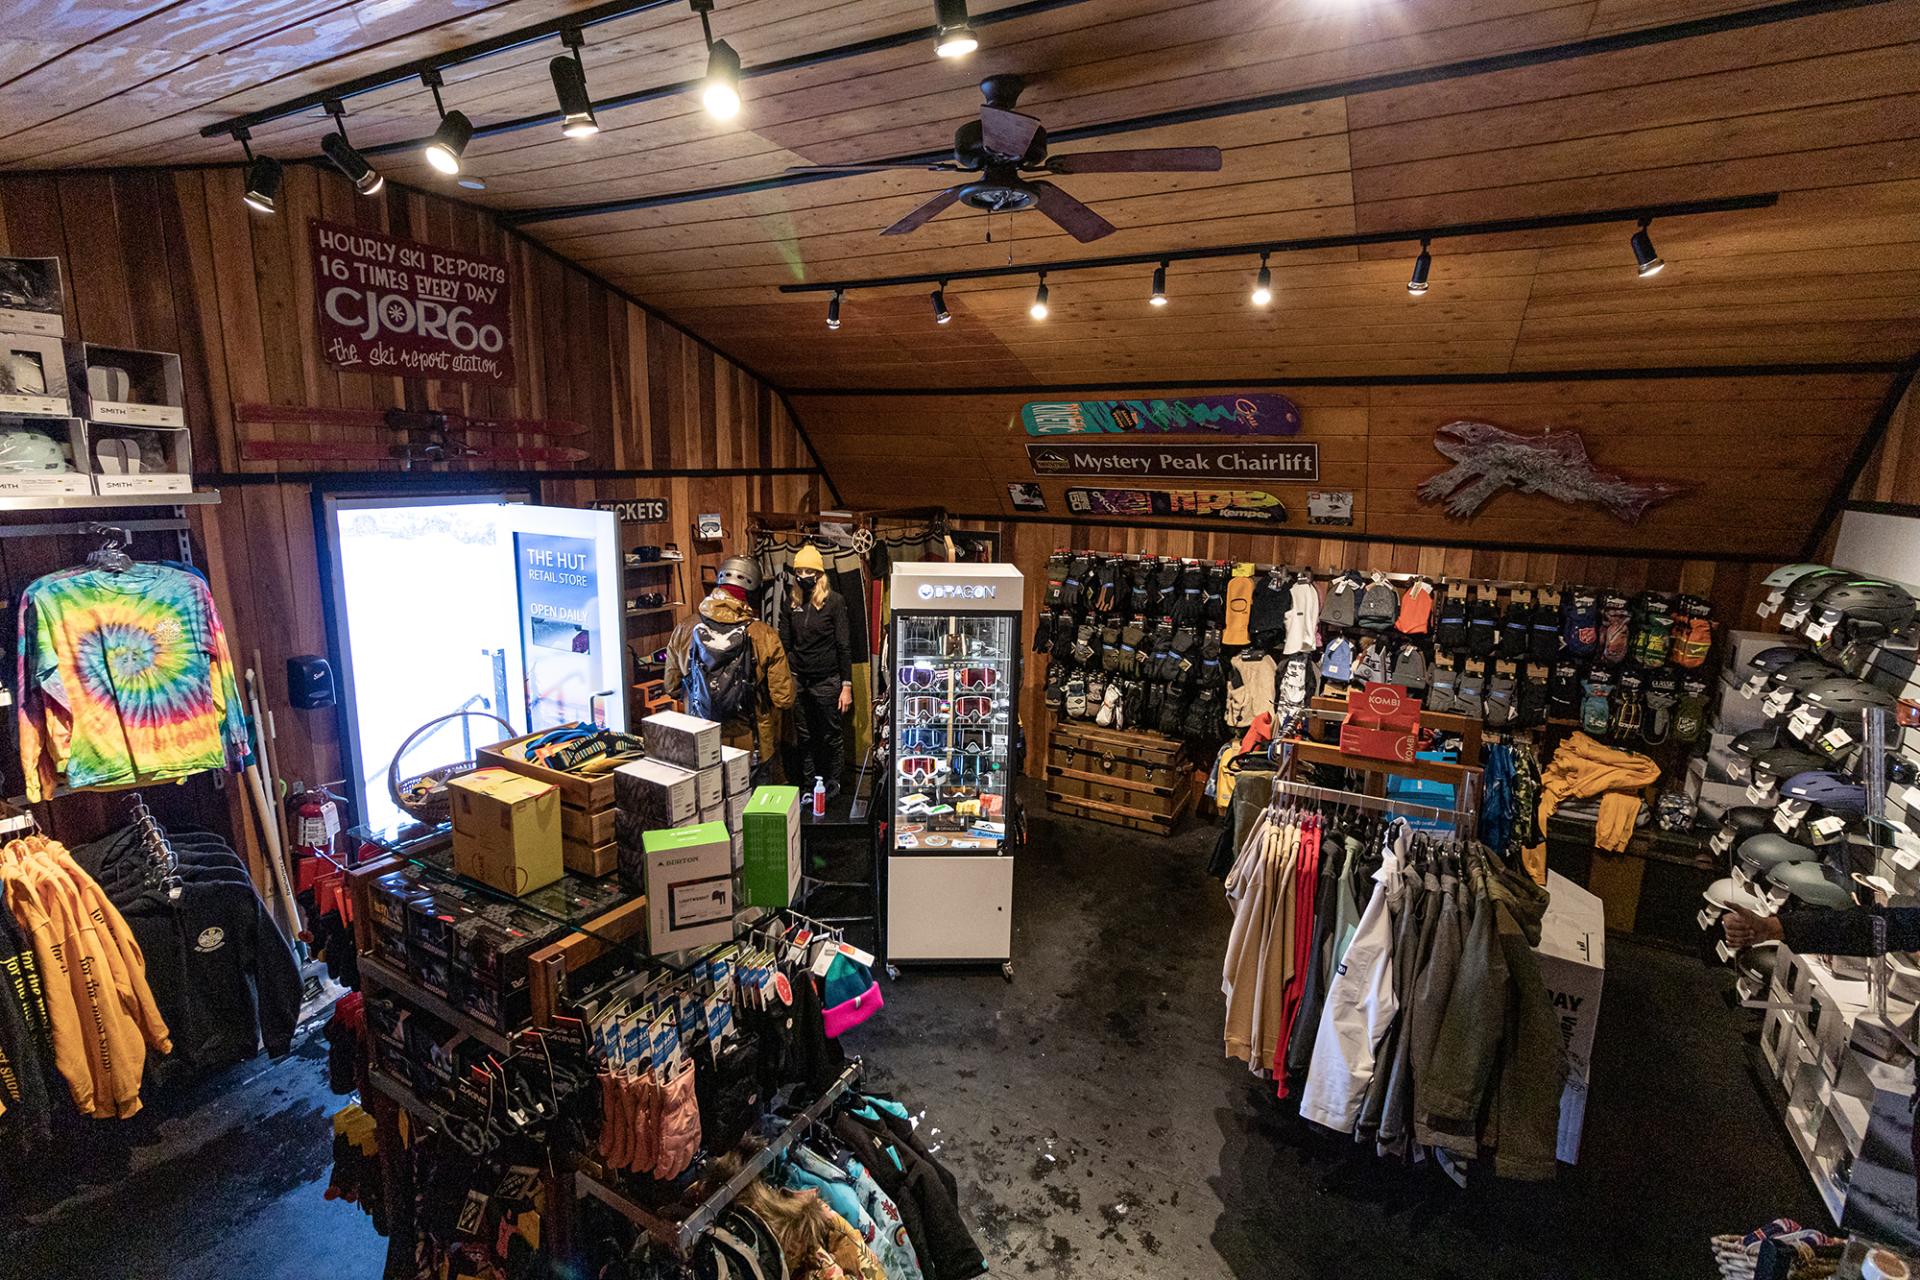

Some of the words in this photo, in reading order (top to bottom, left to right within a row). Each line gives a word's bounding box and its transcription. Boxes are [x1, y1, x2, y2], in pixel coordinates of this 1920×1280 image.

[319, 229, 396, 264] HOURLY
[400, 248, 426, 270] SKI
[431, 254, 506, 284] REPORTS
[320, 254, 350, 281] 16
[353, 261, 409, 292] TIMES
[415, 274, 460, 301] EVERY
[464, 282, 498, 305] DAY
[328, 336, 361, 365] the
[369, 341, 399, 366] ski
[400, 346, 452, 372] report
[452, 353, 503, 380] station
[100, 407, 127, 415] SMITH
[1073, 453, 1152, 474] Mystery
[1160, 454, 1210, 472] Peak
[1216, 452, 1313, 472] Chairlift
[106, 481, 133, 489] SMITH
[1219, 508, 1272, 520] Kemper
[527, 548, 553, 567] THE
[557, 552, 587, 571] HUT
[528, 568, 557, 583] RETAIL
[559, 571, 588, 587] STORE
[530, 602, 557, 618] OPEN
[558, 605, 588, 623] DAILY
[1368, 695, 1401, 707] KOMBI
[0, 956, 21, 977] for
[79, 955, 96, 977] for
[84, 977, 101, 1003] the
